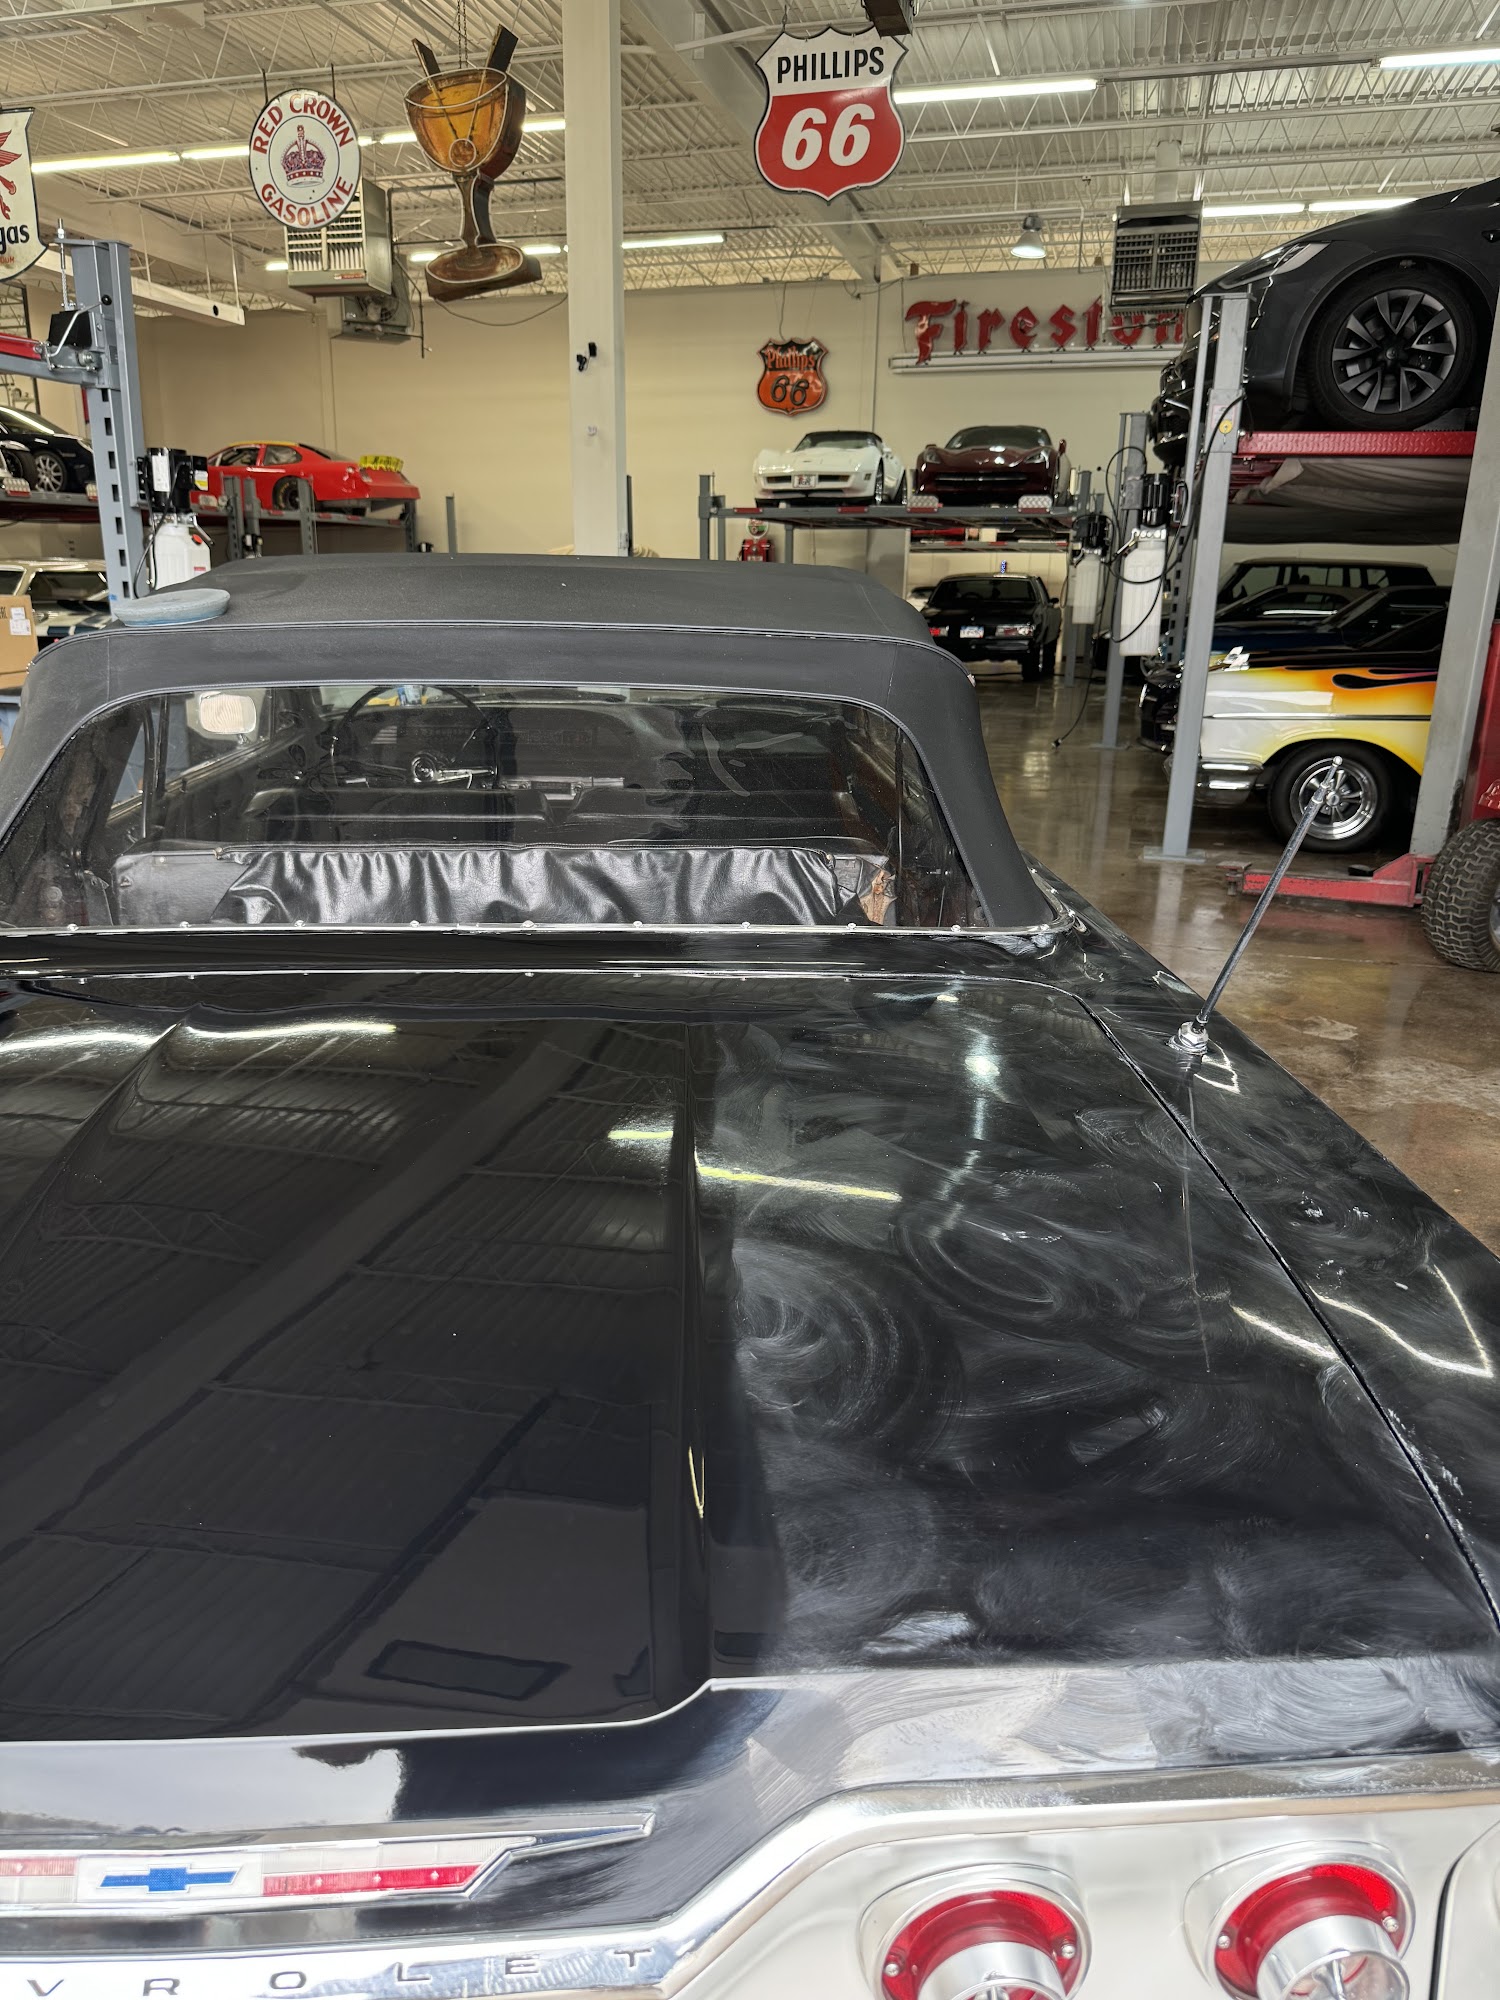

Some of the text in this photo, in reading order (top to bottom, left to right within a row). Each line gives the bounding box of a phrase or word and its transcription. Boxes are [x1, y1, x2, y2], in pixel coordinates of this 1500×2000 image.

[777, 46, 884, 83] PHILLIPS
[253, 93, 354, 154] RED CROWN
[781, 103, 876, 171] 66
[261, 176, 354, 226] GASOLINE
[764, 346, 815, 373] Phillips
[770, 375, 810, 406] 66
[27, 1949, 653, 1997] VROLET
